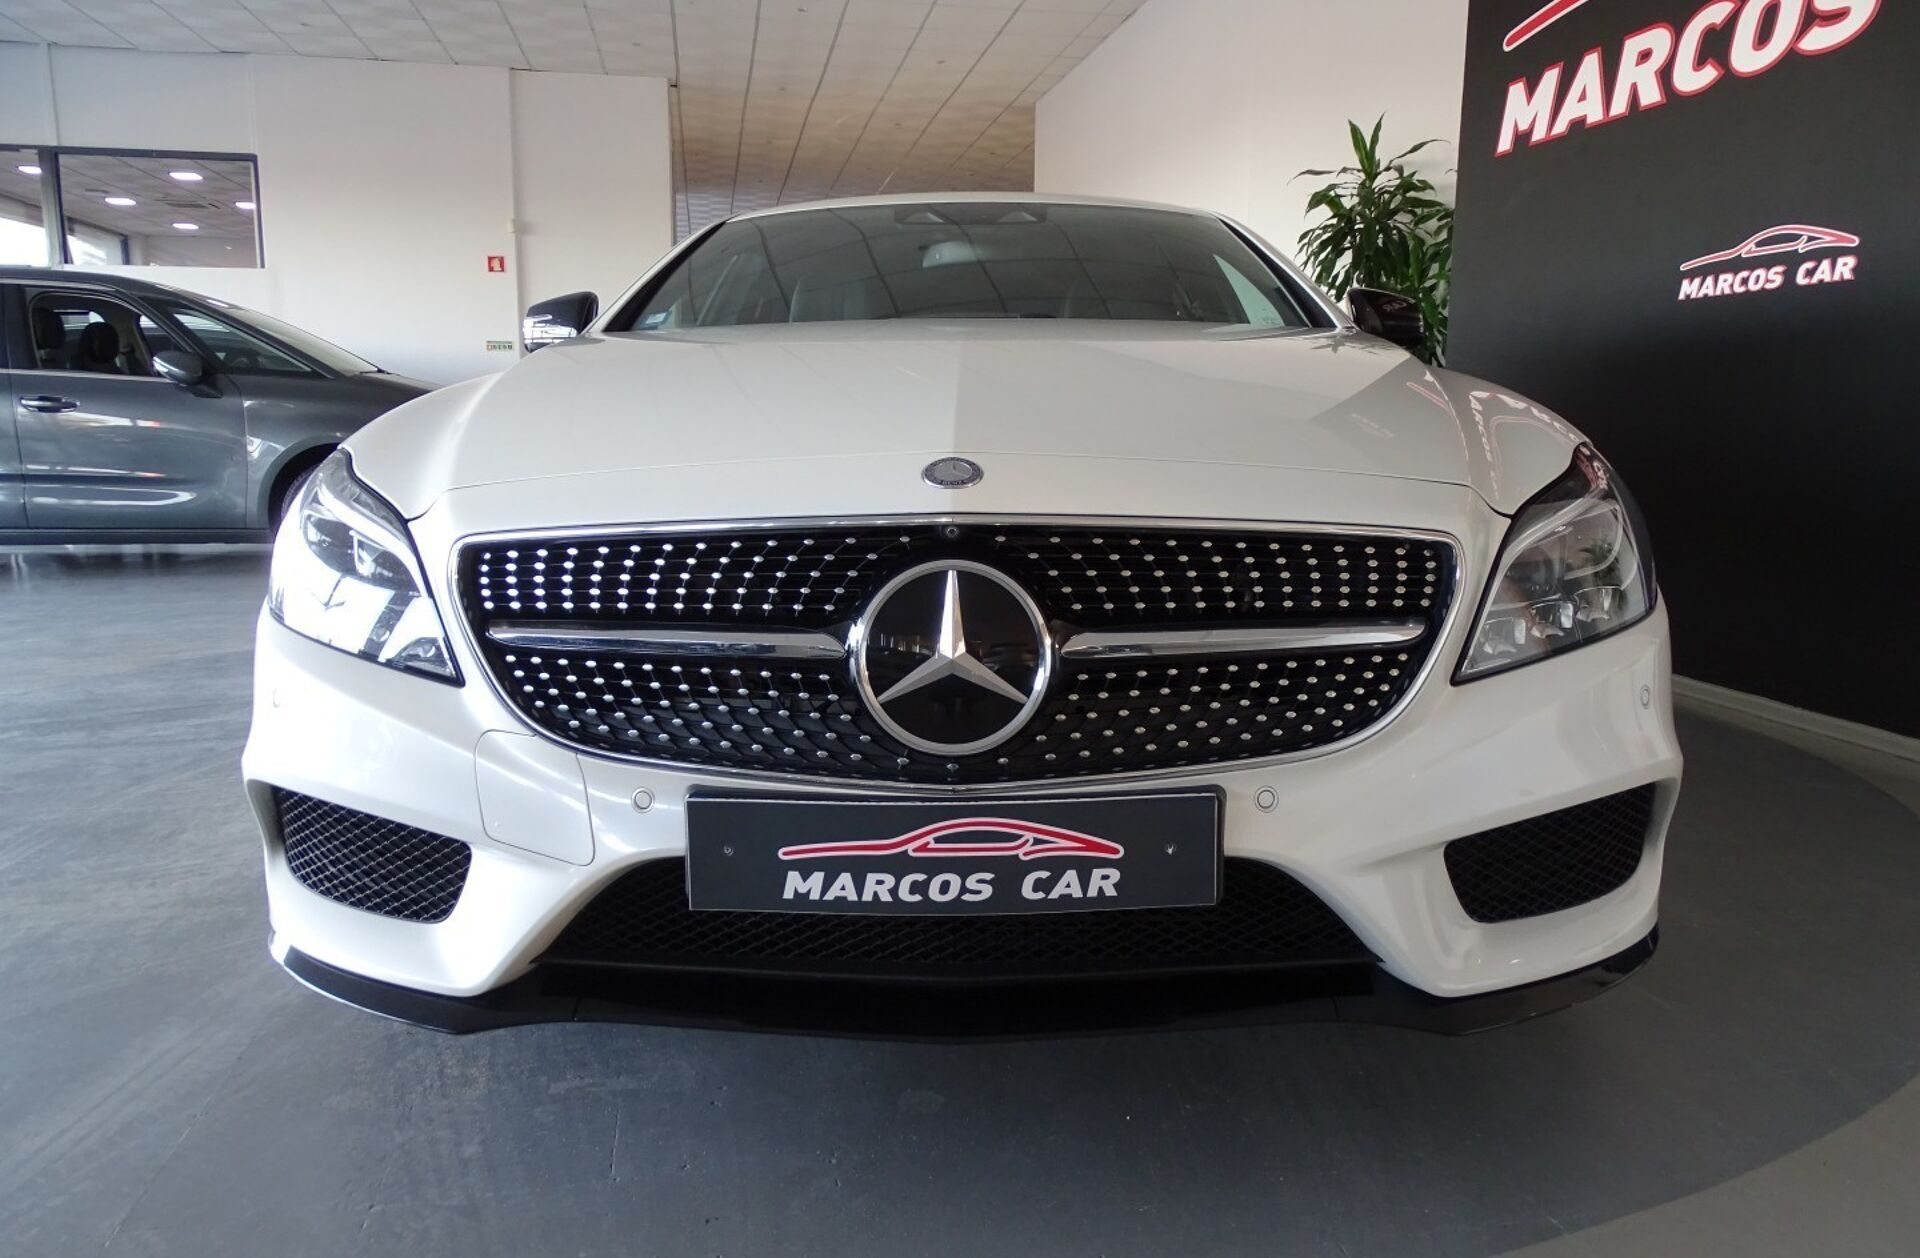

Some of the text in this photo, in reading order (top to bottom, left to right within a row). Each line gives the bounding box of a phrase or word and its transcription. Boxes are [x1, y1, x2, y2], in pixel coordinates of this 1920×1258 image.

[1493, 0, 1883, 157] MARCOS
[1677, 255, 1859, 301] MARCOS CAR
[782, 868, 1121, 902] MARCOS CAR
